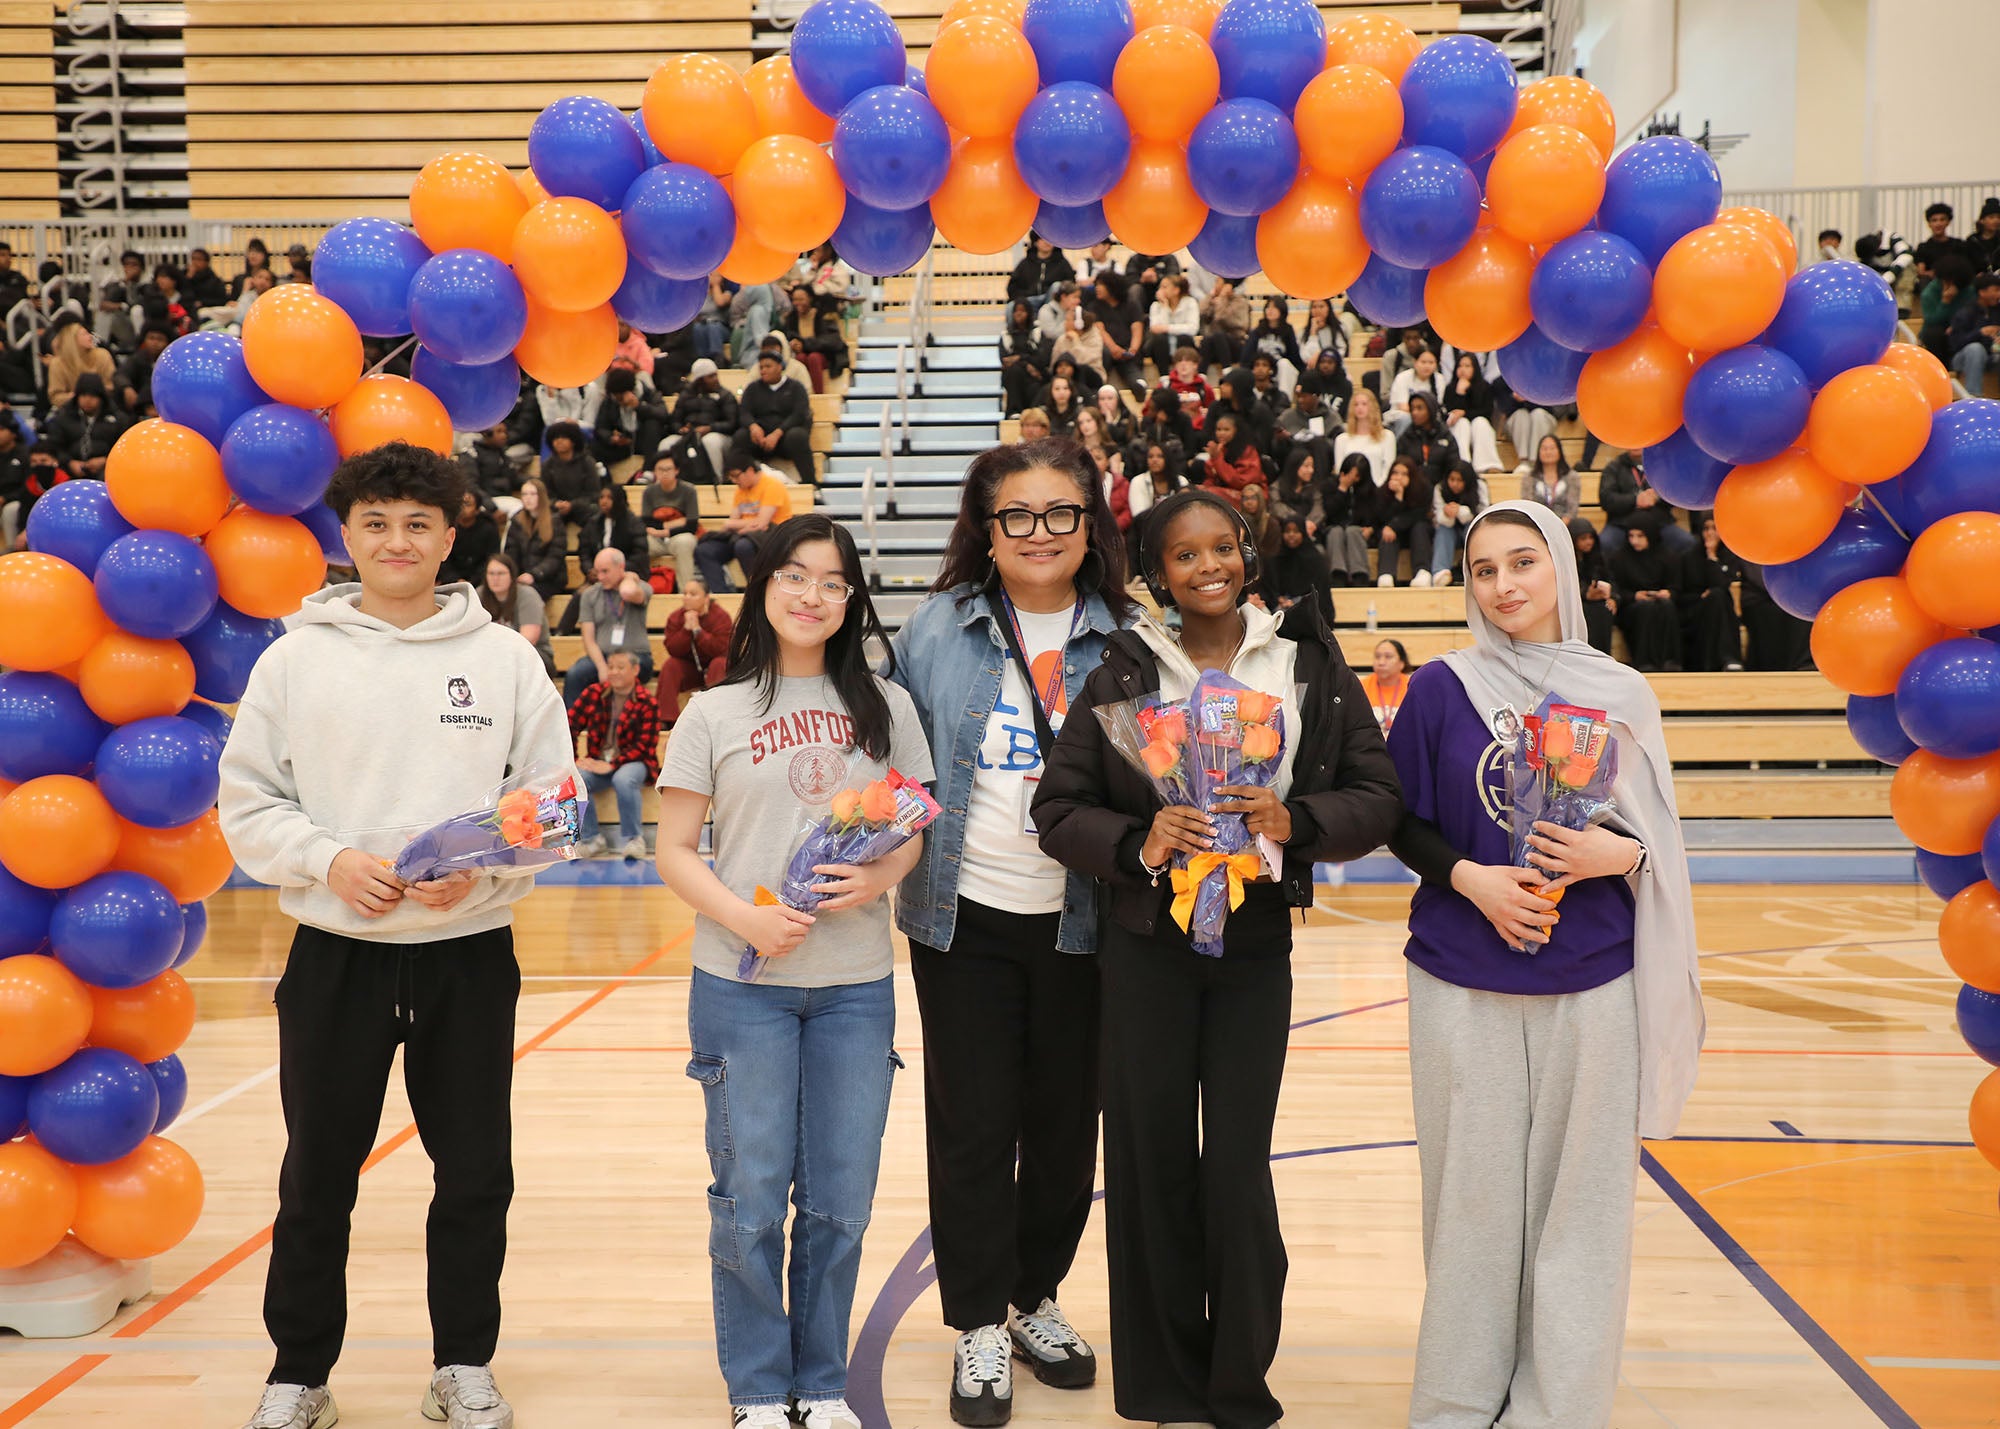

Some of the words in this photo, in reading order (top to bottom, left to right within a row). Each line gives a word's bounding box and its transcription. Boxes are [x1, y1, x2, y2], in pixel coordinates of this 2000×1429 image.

[440, 714, 493, 727] ESSENTIALS
[750, 709, 862, 766] STANFOR
[894, 804, 921, 827] HERSHEY'S
